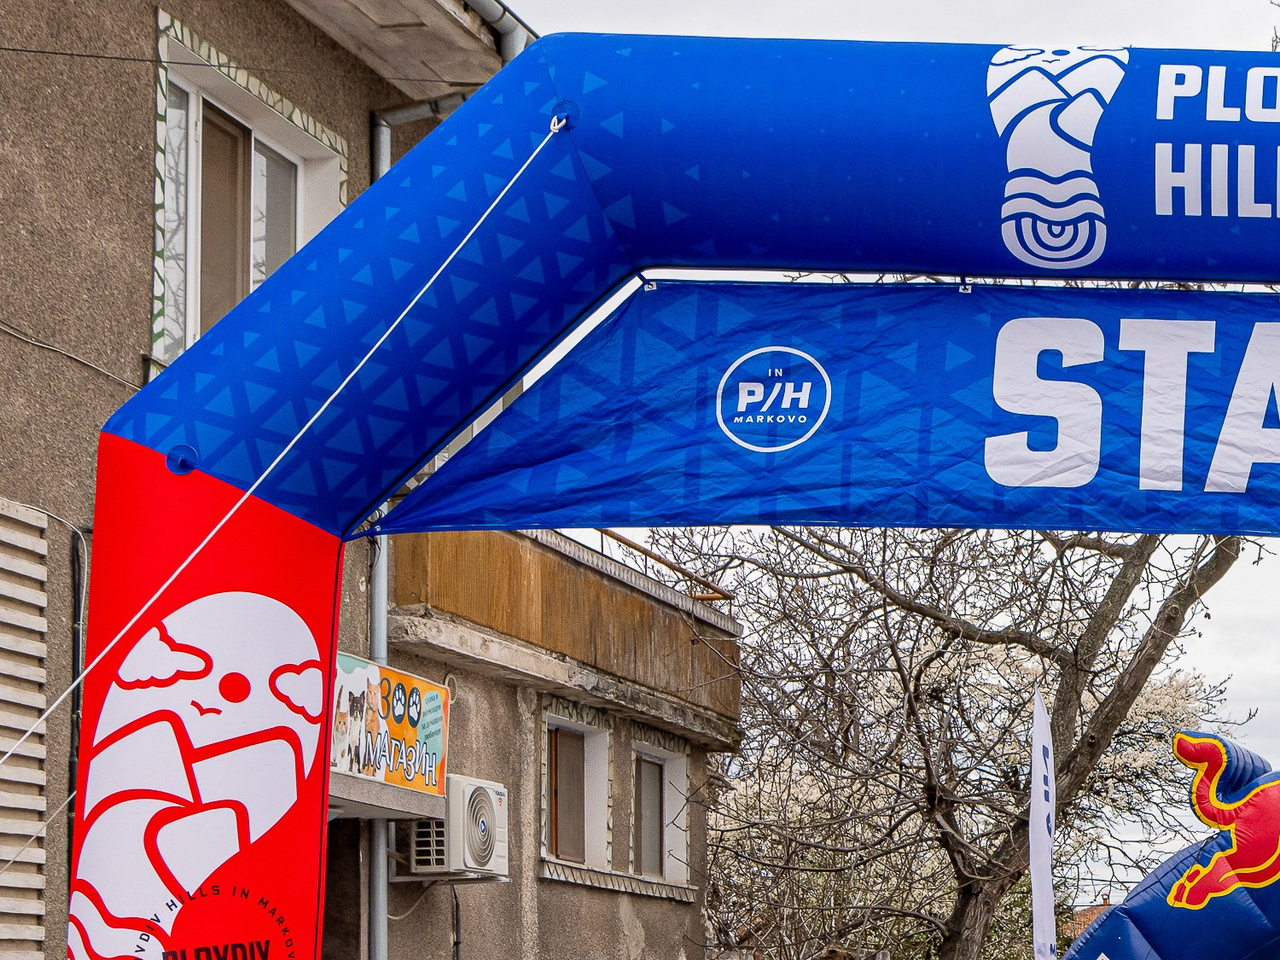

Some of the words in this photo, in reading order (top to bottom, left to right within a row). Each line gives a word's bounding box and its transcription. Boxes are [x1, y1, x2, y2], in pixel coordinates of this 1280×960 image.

[768, 368, 783, 377] IN
[737, 381, 812, 412] P/H
[733, 415, 807, 423] MARKOVO
[365, 731, 437, 786] МАГАЗИН
[166, 885, 220, 911] HILLS
[232, 886, 250, 899] IN
